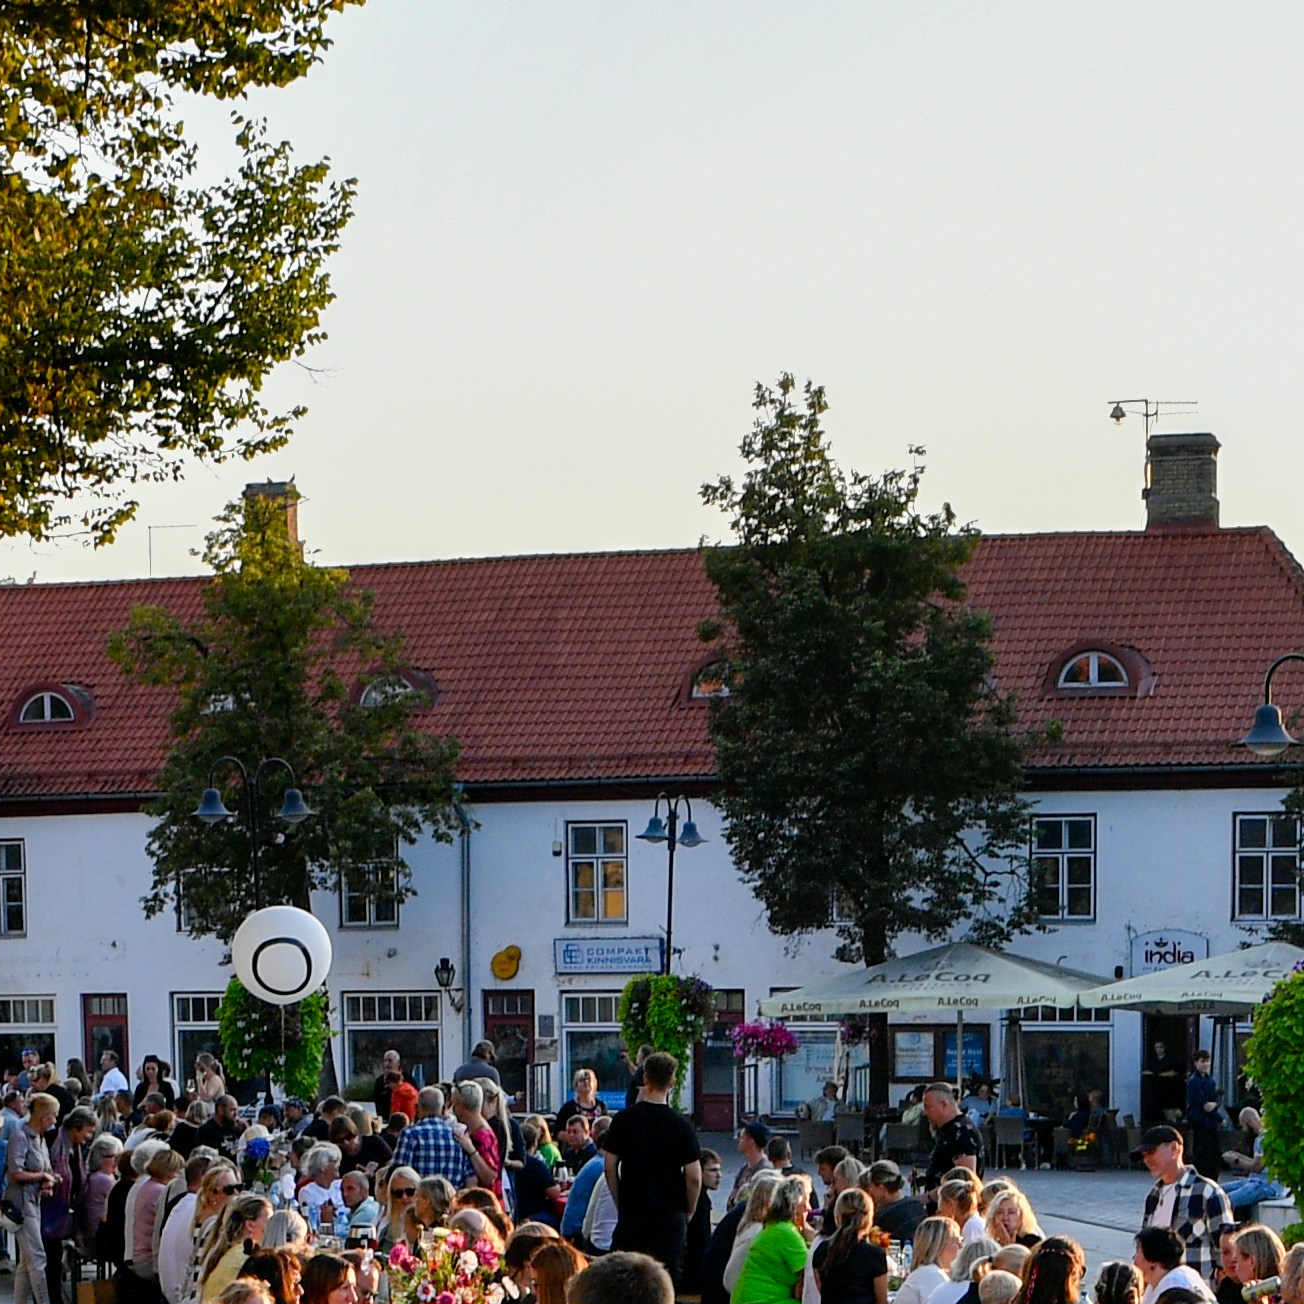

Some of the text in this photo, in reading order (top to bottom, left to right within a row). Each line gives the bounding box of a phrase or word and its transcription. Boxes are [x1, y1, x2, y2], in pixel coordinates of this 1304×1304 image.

[1144, 940, 1195, 964] india
[1190, 969, 1293, 980] A.LeC
[858, 999, 899, 1010] A.LeCoq
[937, 996, 978, 1007] A.LeCoq
